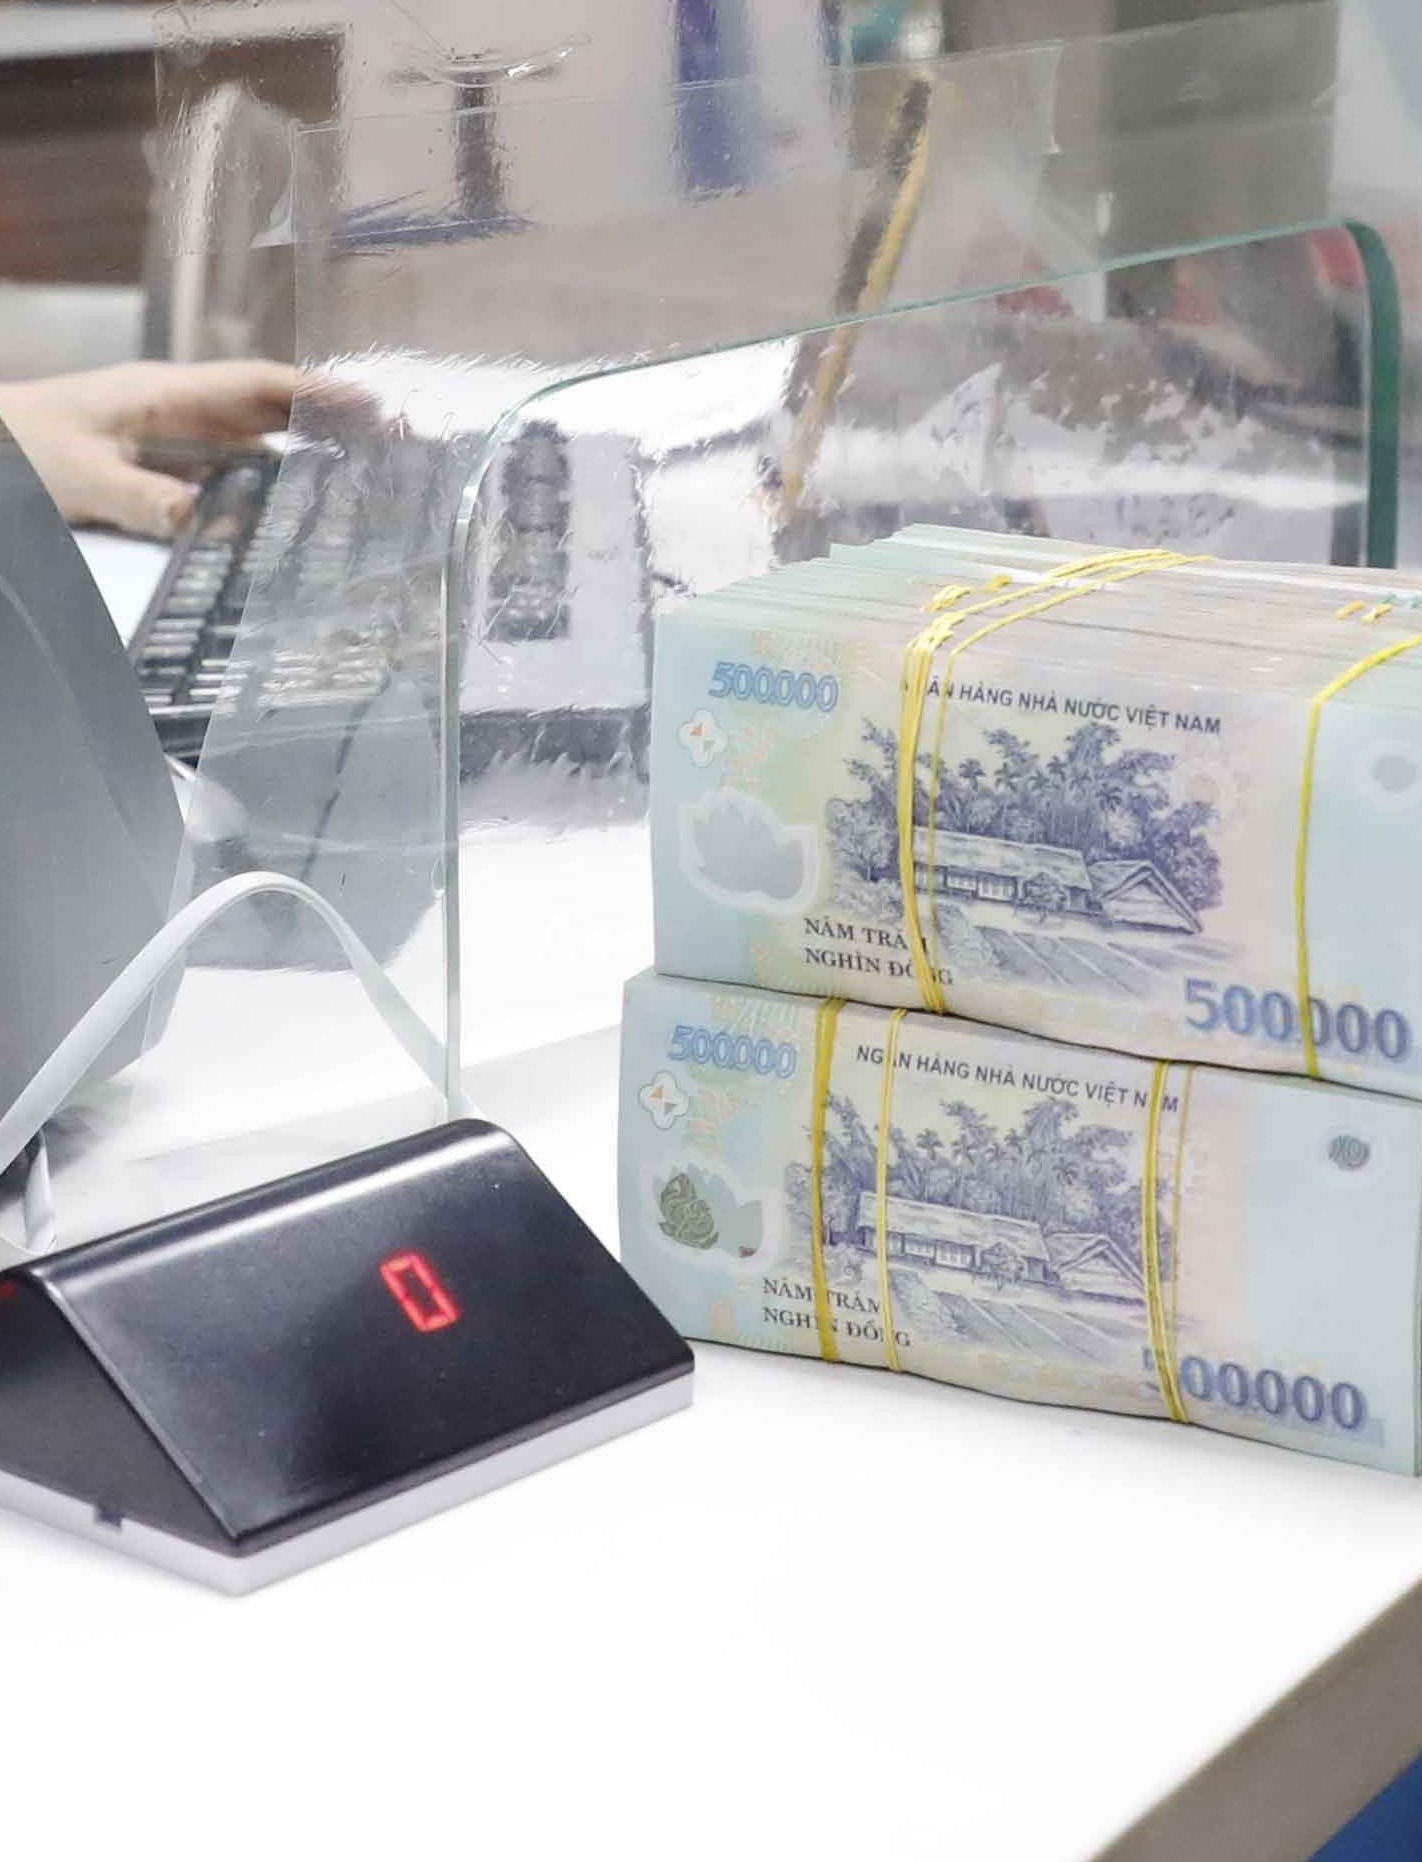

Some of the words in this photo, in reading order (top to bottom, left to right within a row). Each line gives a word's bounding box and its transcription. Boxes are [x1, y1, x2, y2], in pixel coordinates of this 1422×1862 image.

[960, 680, 1013, 707] HÀNG
[1018, 690, 1058, 713] NHÀ
[1064, 696, 1120, 722] NƯỚC
[1126, 704, 1170, 731] VIỆT
[1174, 713, 1221, 735] NAM
[804, 916, 855, 941] NĂM
[861, 926, 927, 954] TRĂ
[804, 947, 880, 974] NGHÌN
[856, 1045, 912, 1069] NGN
[916, 1053, 970, 1080] HÀNG
[975, 1065, 1015, 1087] NHÀ
[1022, 1072, 1079, 1097] NƯỚC
[1085, 1081, 1129, 1108] VIỆT
[1133, 1091, 1179, 1113] NM
[379, 1253, 459, 1333] 0
[763, 1277, 813, 1302] NĂM
[763, 1306, 838, 1332] NGH
